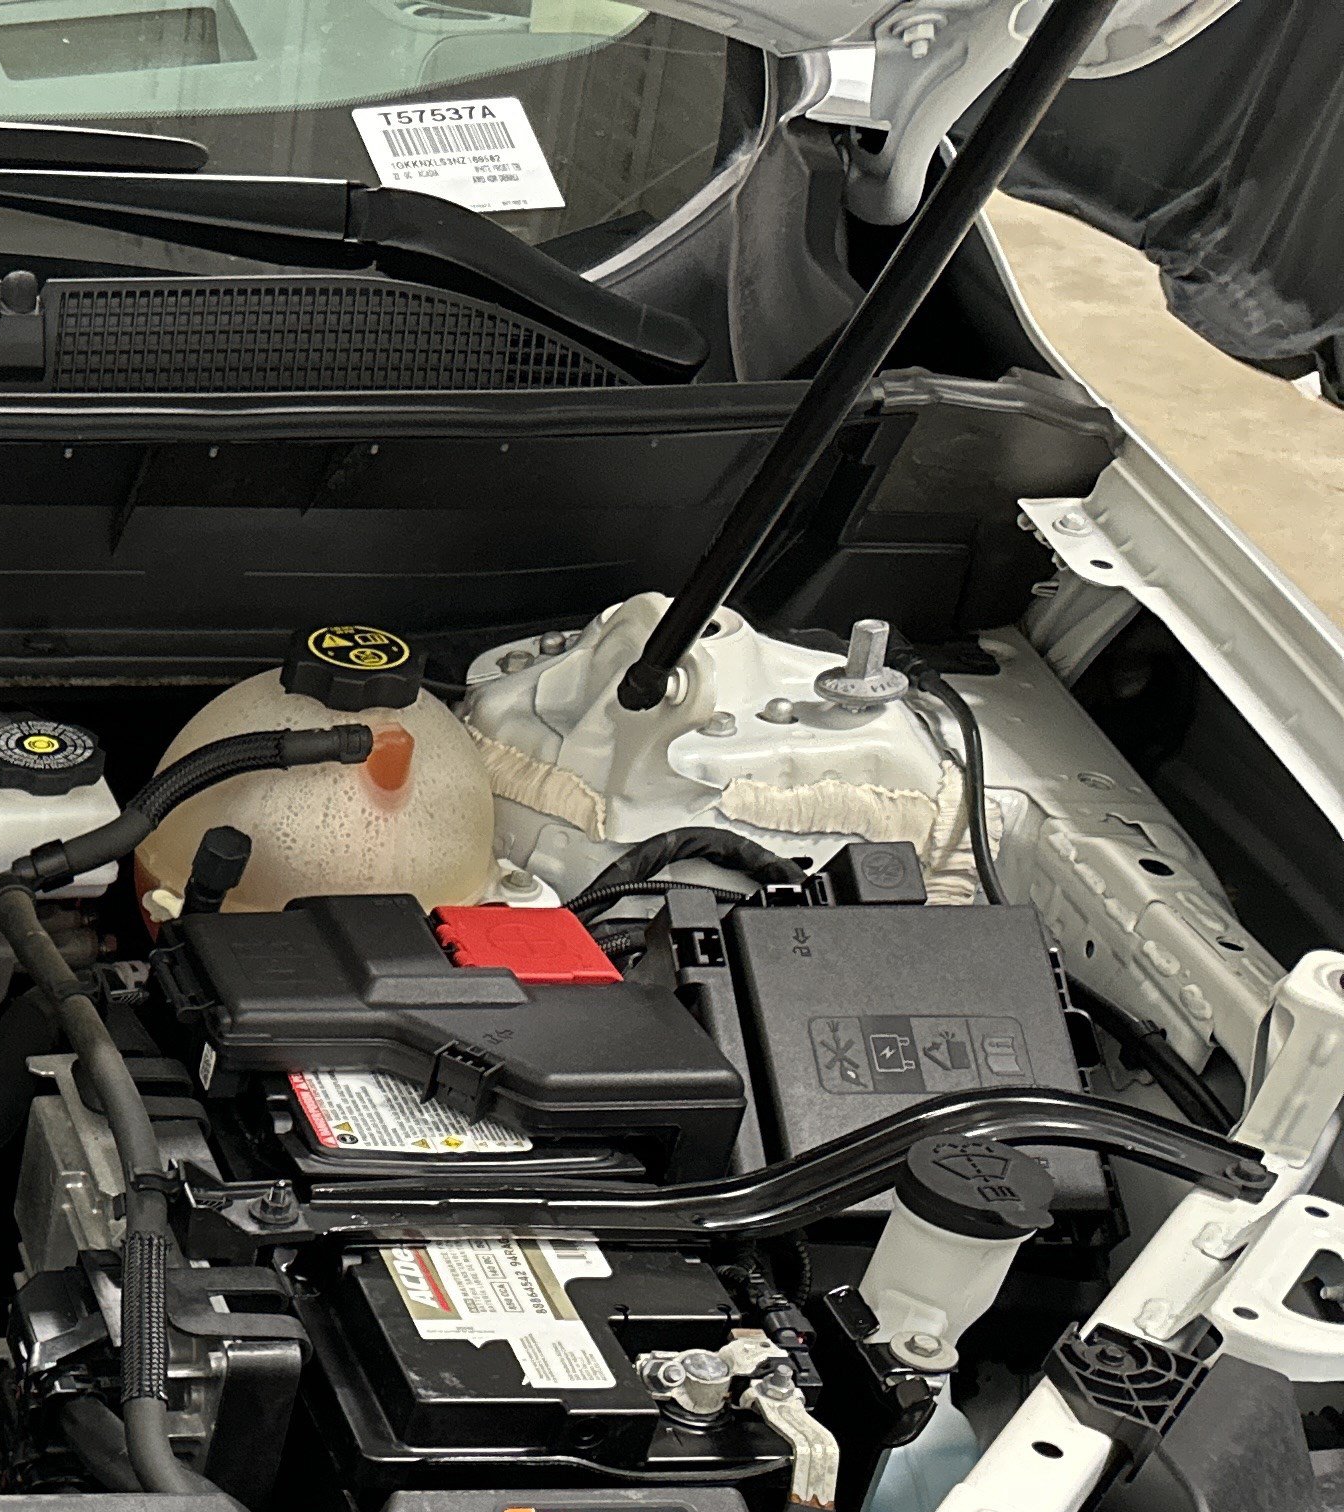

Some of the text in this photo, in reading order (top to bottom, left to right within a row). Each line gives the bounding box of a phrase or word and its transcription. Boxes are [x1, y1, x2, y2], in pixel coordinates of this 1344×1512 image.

[378, 104, 497, 127] T57537A
[499, 1239, 522, 1267] 94RAG
[391, 1244, 439, 1308] ACDe
